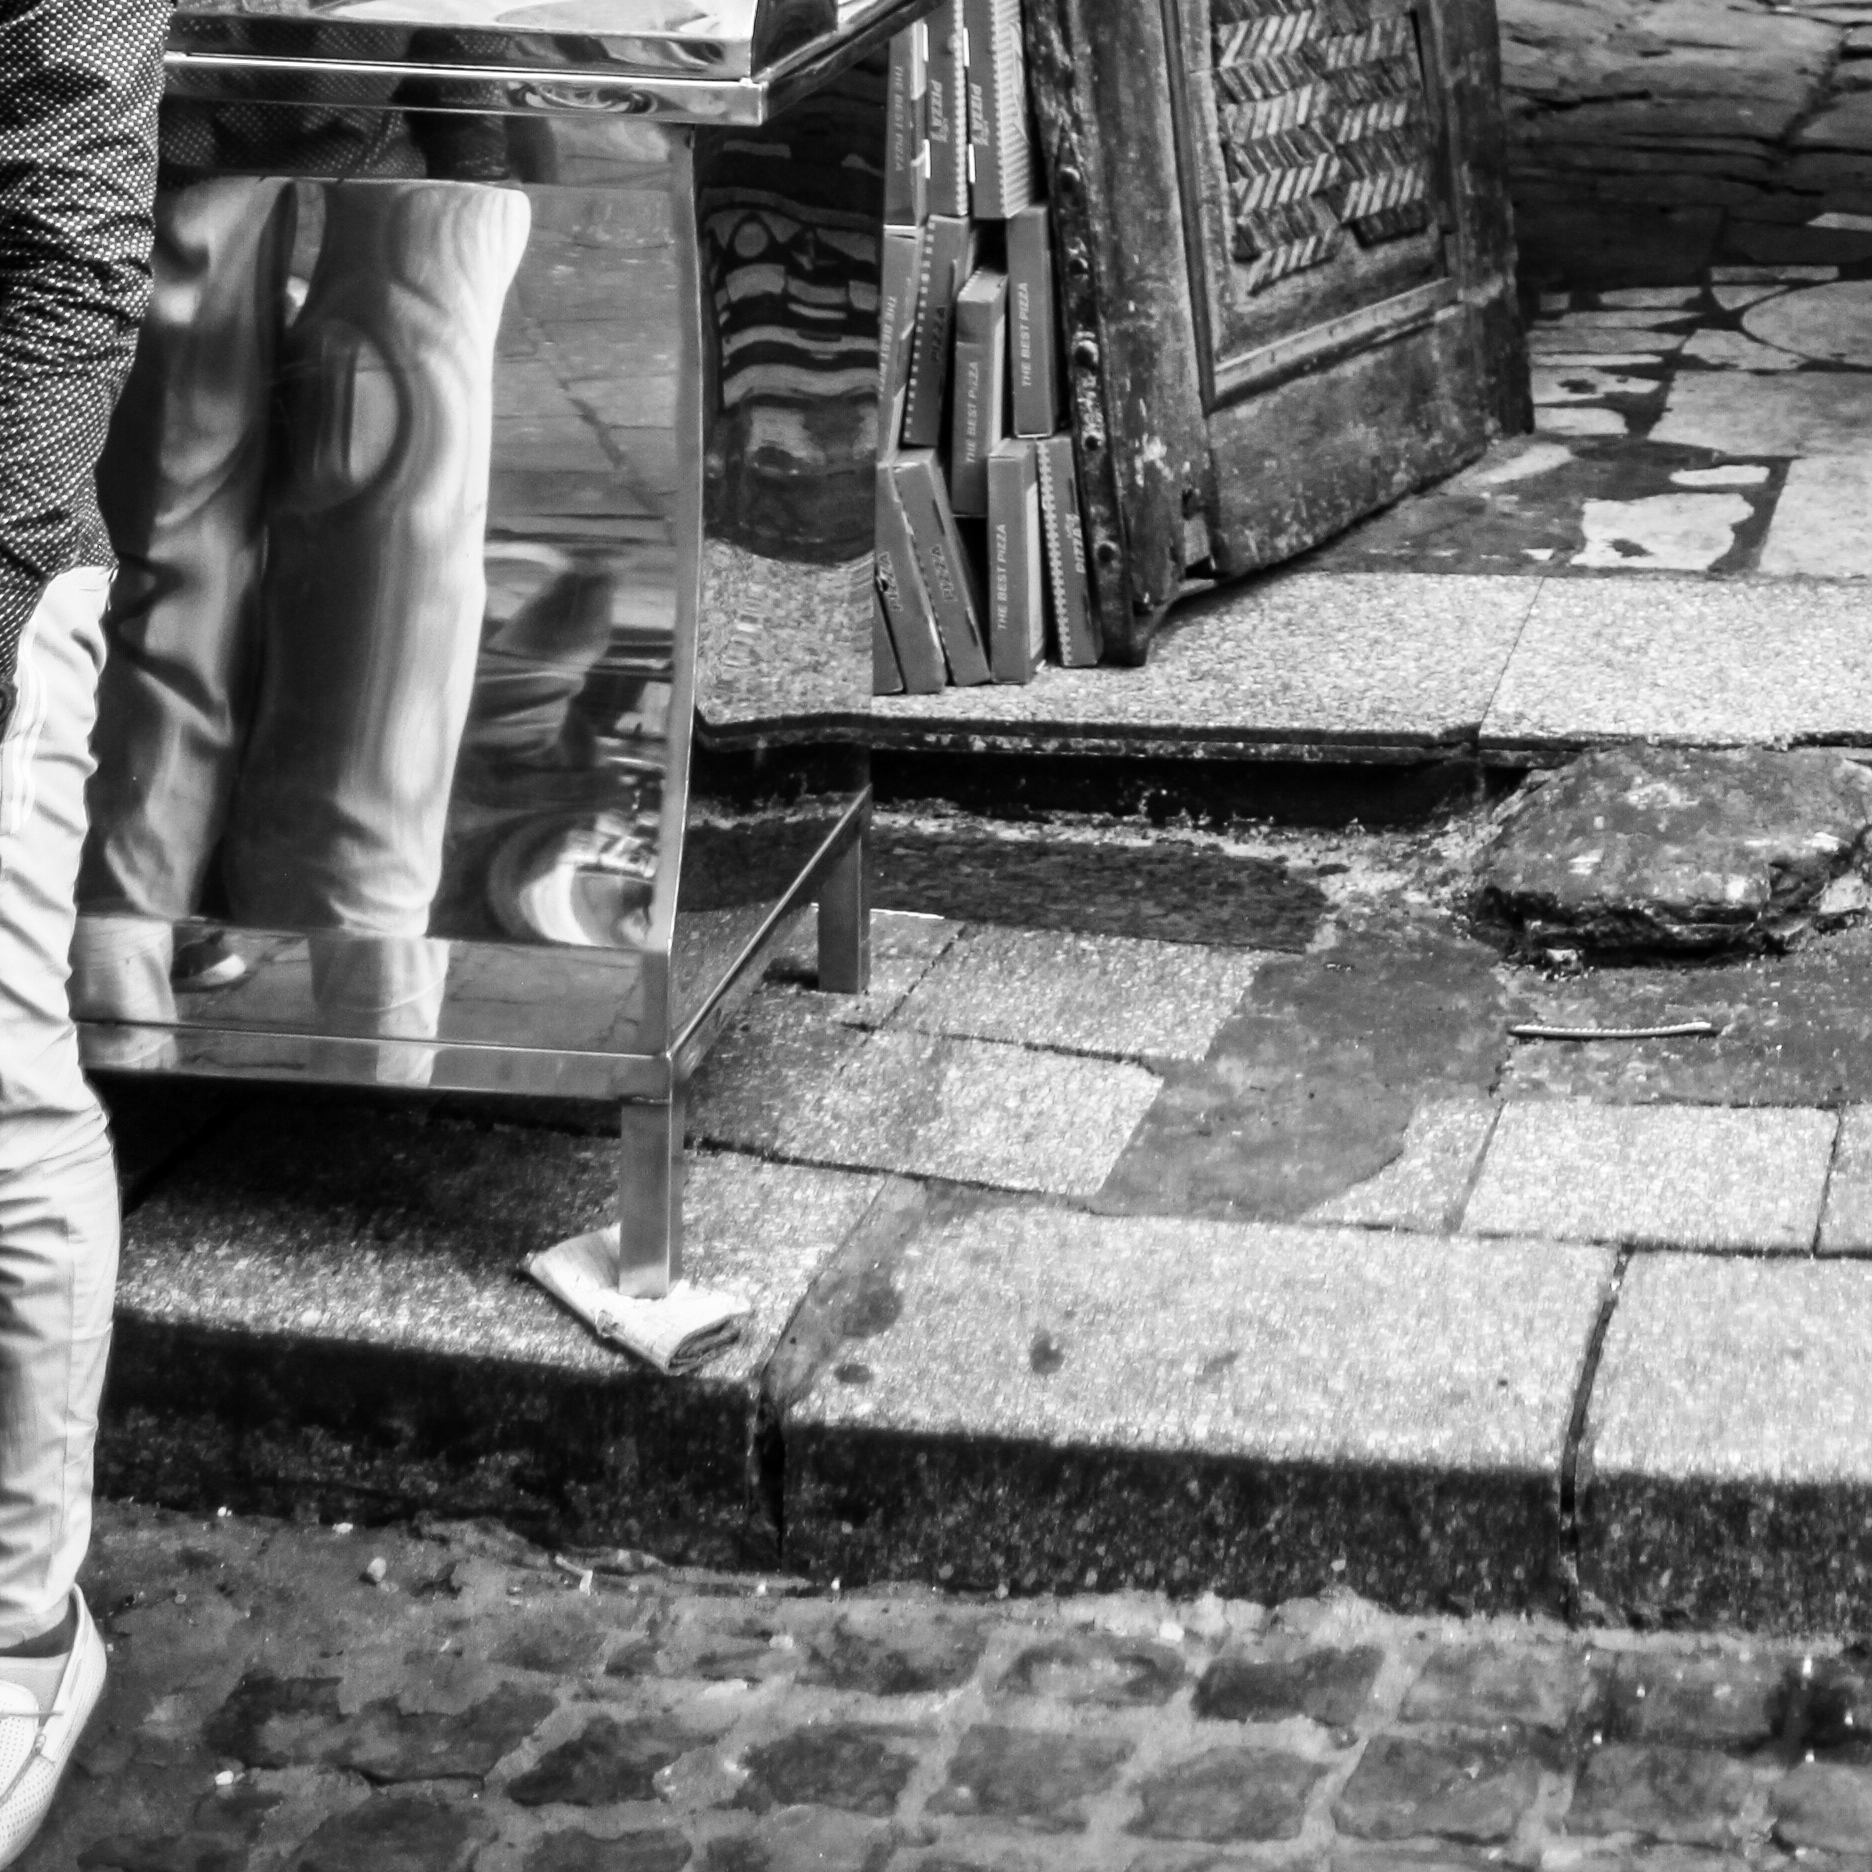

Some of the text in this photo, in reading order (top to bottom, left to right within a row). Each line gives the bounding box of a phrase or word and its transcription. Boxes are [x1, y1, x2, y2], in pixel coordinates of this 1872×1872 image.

[930, 79, 943, 127] PIZZA
[970, 81, 984, 131] PIZZA
[1017, 282, 1031, 387] THE BEST PIZZA
[966, 361, 980, 464] THE BEST PIZZA
[995, 524, 1008, 630] THE BEST PIZZA
[1072, 527, 1086, 574] PIZZA
